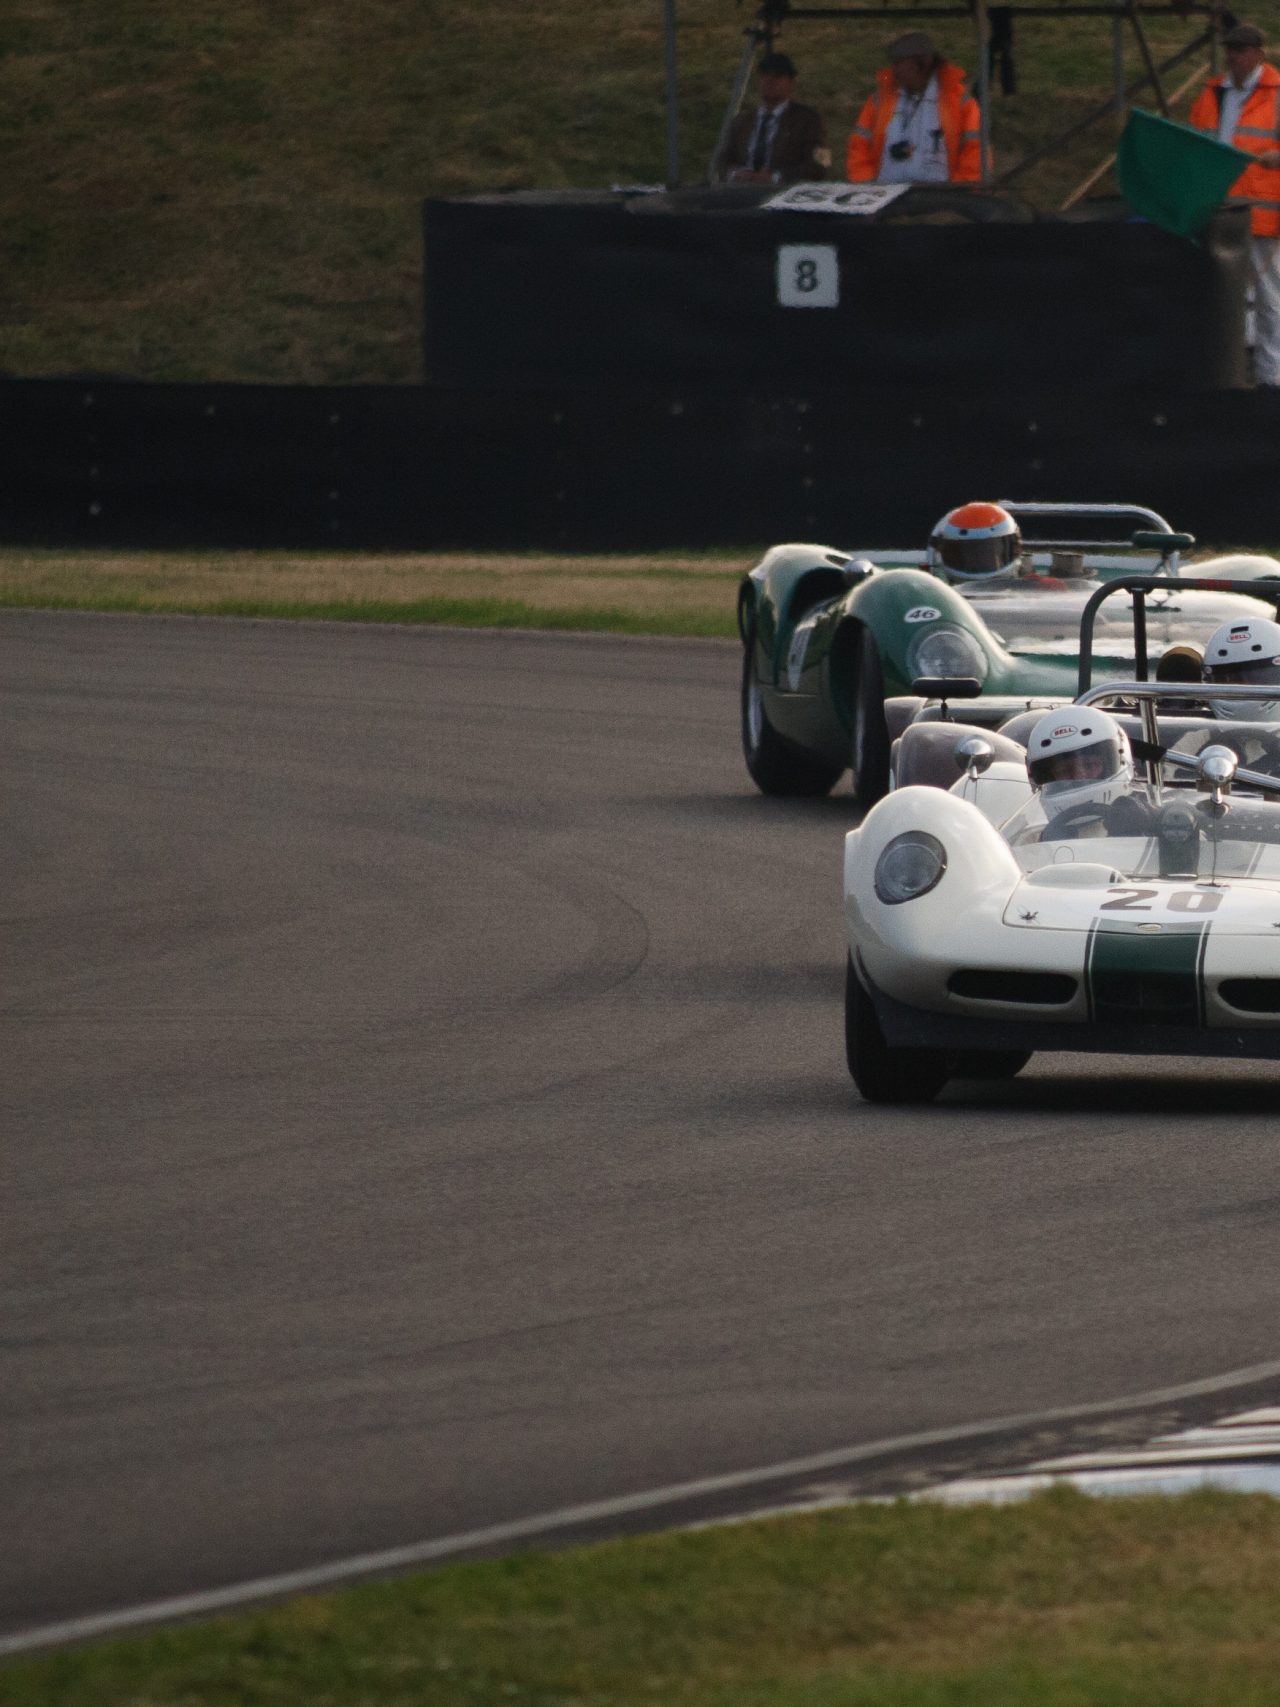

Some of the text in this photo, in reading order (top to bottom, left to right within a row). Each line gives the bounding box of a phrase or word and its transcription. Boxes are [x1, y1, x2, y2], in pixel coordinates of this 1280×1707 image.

[798, 259, 818, 292] 8
[908, 610, 936, 619] 46
[1054, 727, 1073, 737] BELL
[1100, 888, 1223, 913] 20
